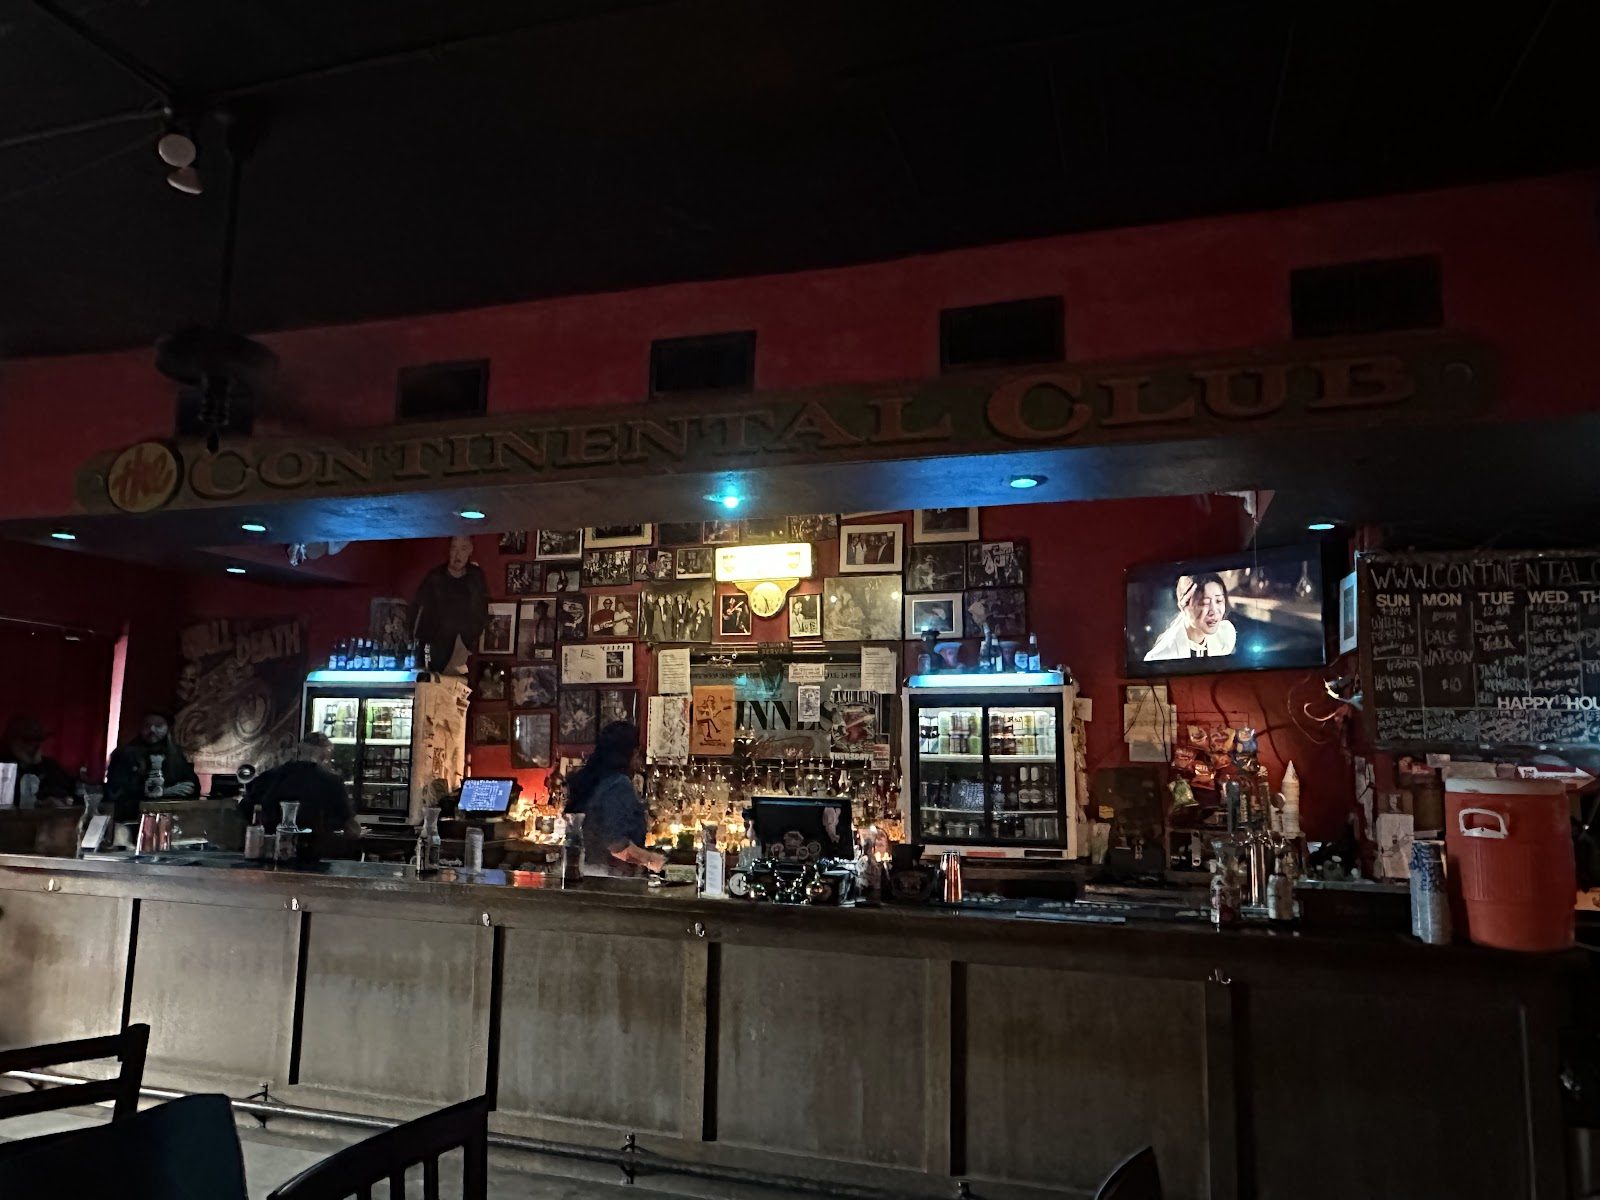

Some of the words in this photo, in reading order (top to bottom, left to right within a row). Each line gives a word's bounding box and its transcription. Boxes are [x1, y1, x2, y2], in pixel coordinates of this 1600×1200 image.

[1375, 593, 1411, 607] SUN
[1422, 592, 1463, 607] MON
[1477, 591, 1515, 605] TUE
[1527, 590, 1570, 604] WED
[1425, 629, 1457, 646] DALE
[1497, 695, 1555, 710] HAPPY
